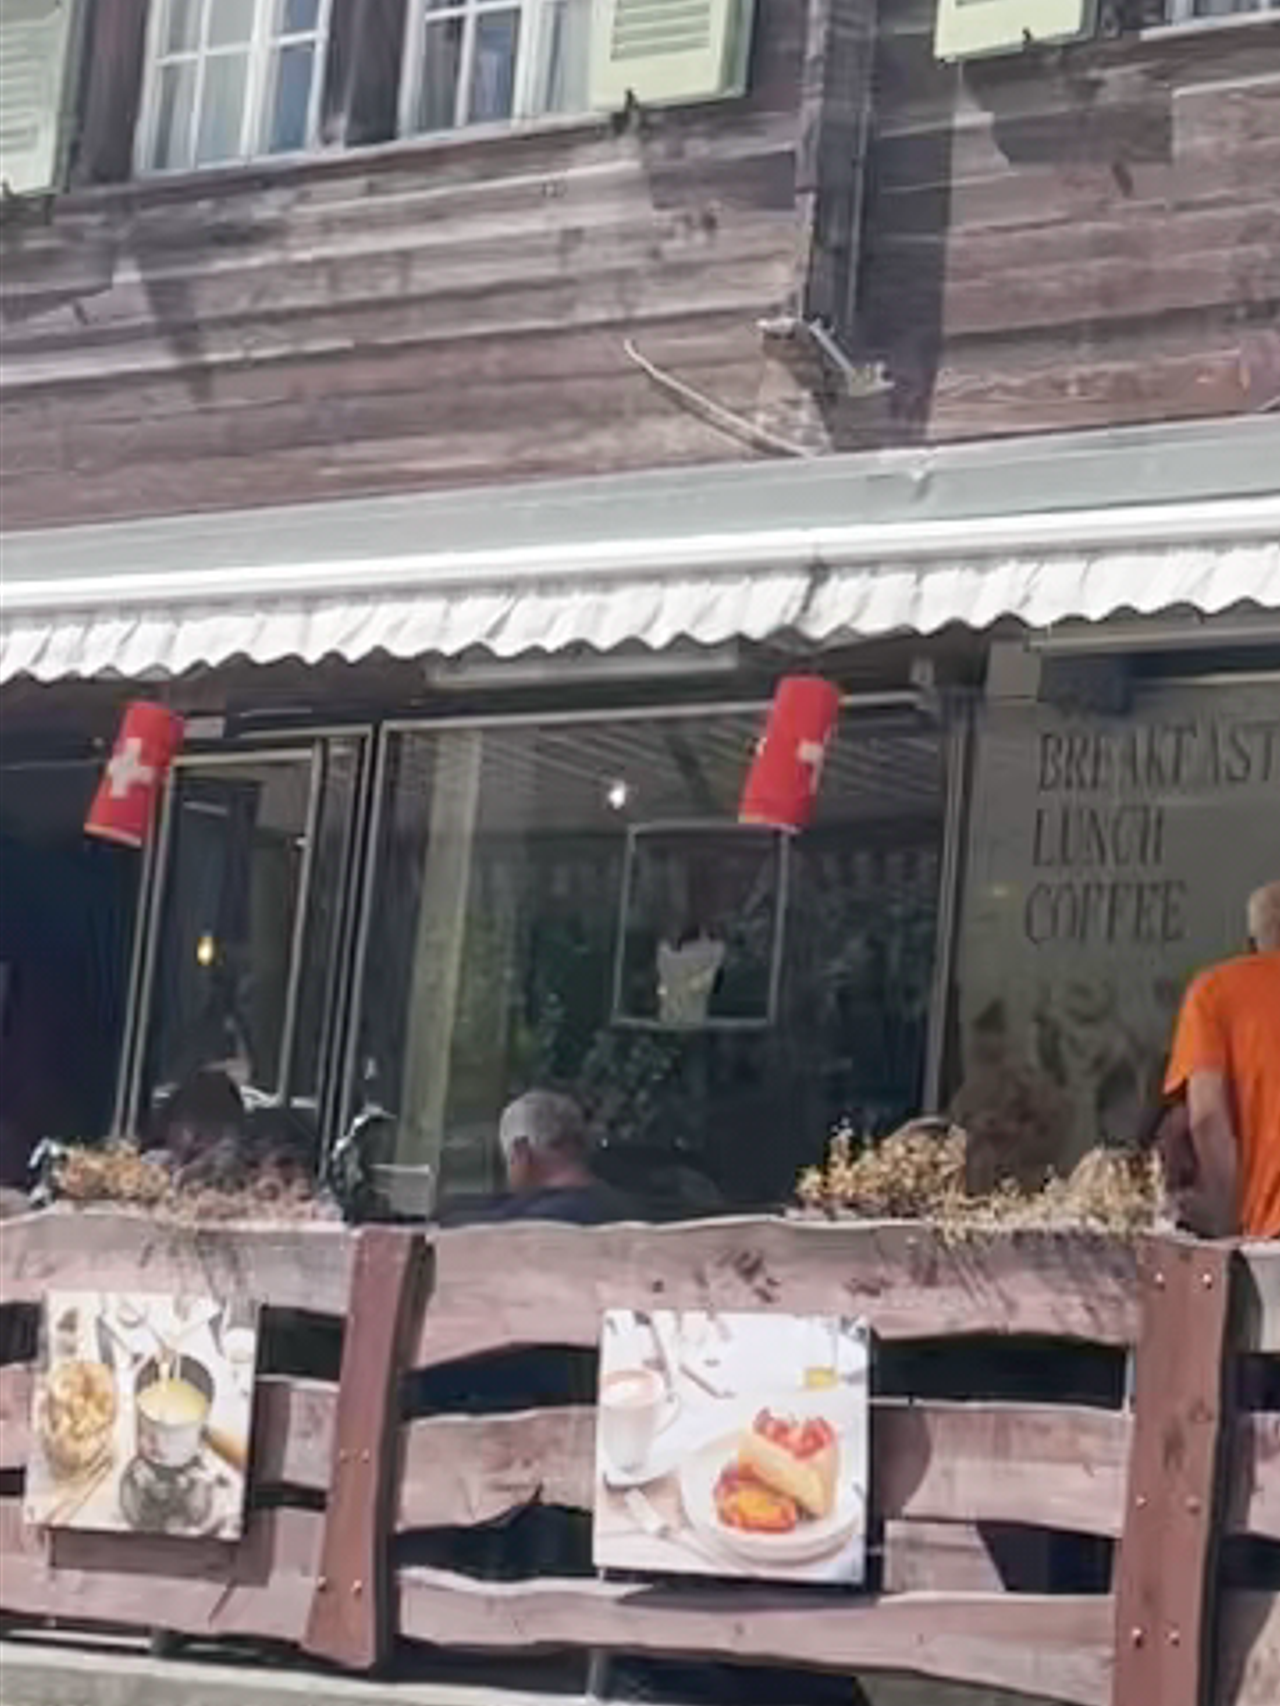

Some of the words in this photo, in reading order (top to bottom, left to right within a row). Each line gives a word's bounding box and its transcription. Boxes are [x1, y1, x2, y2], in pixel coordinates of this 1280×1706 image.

[1037, 716, 1280, 792] BREAKFAST
[1031, 804, 1164, 867] LUNCH
[1024, 880, 1189, 945] COFFEE
